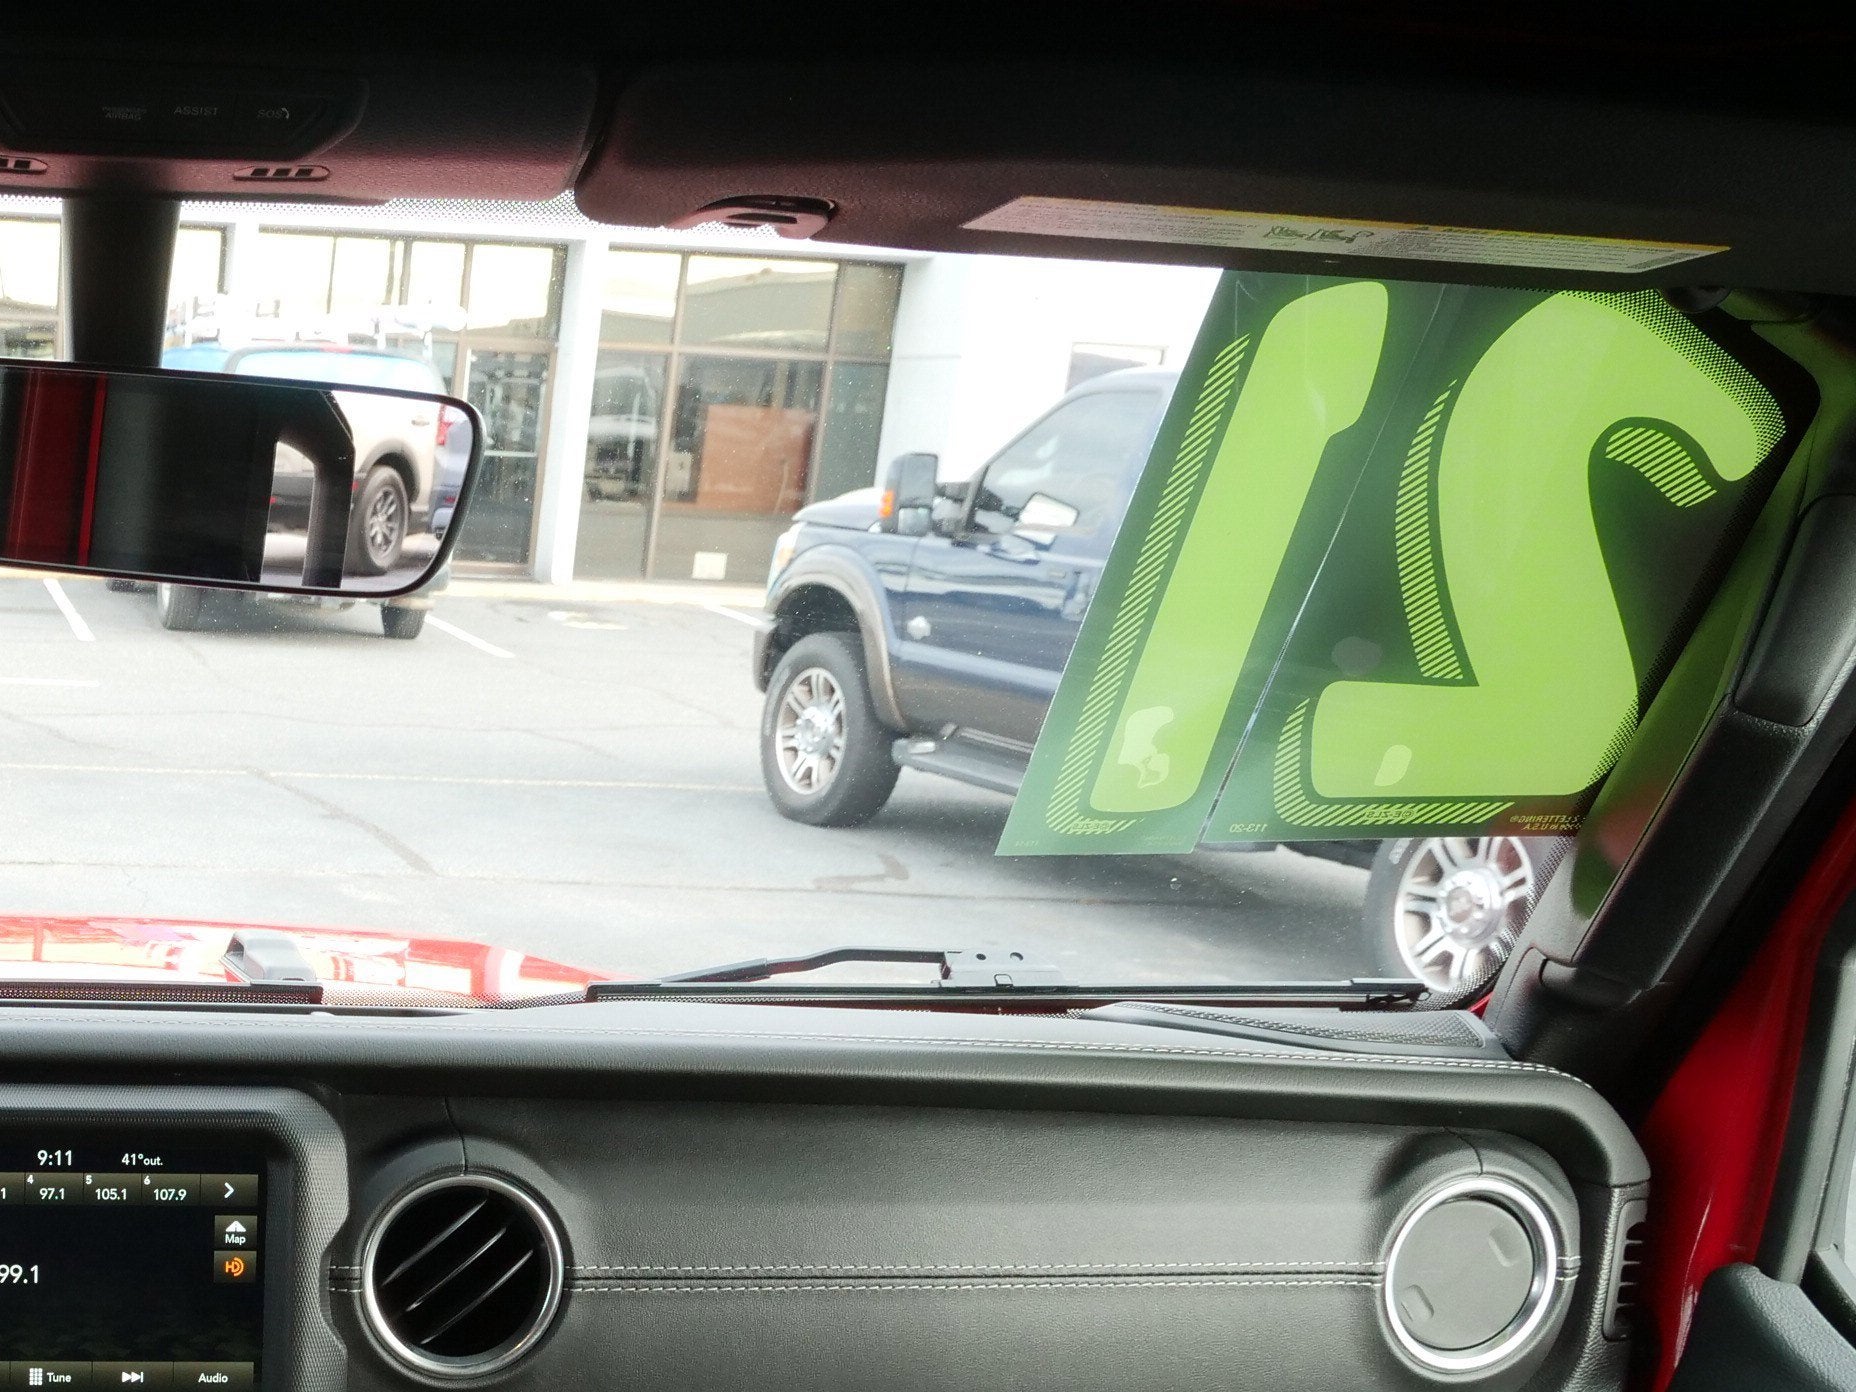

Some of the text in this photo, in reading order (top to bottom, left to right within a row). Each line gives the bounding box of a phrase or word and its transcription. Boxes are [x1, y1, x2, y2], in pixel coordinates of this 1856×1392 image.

[173, 106, 219, 116] ASSIST
[256, 108, 281, 119] SOS
[37, 1150, 74, 1167] 9:11
[27, 1174, 34, 1184] 4
[85, 1175, 92, 1185] 5
[144, 1176, 151, 1185] 6
[39, 1187, 65, 1200] 97.1
[95, 1187, 128, 1201] 105.1
[153, 1188, 187, 1202] 107.9
[225, 1233, 246, 1246] Map
[46, 1372, 72, 1384] Tune
[198, 1372, 228, 1384] Audio
